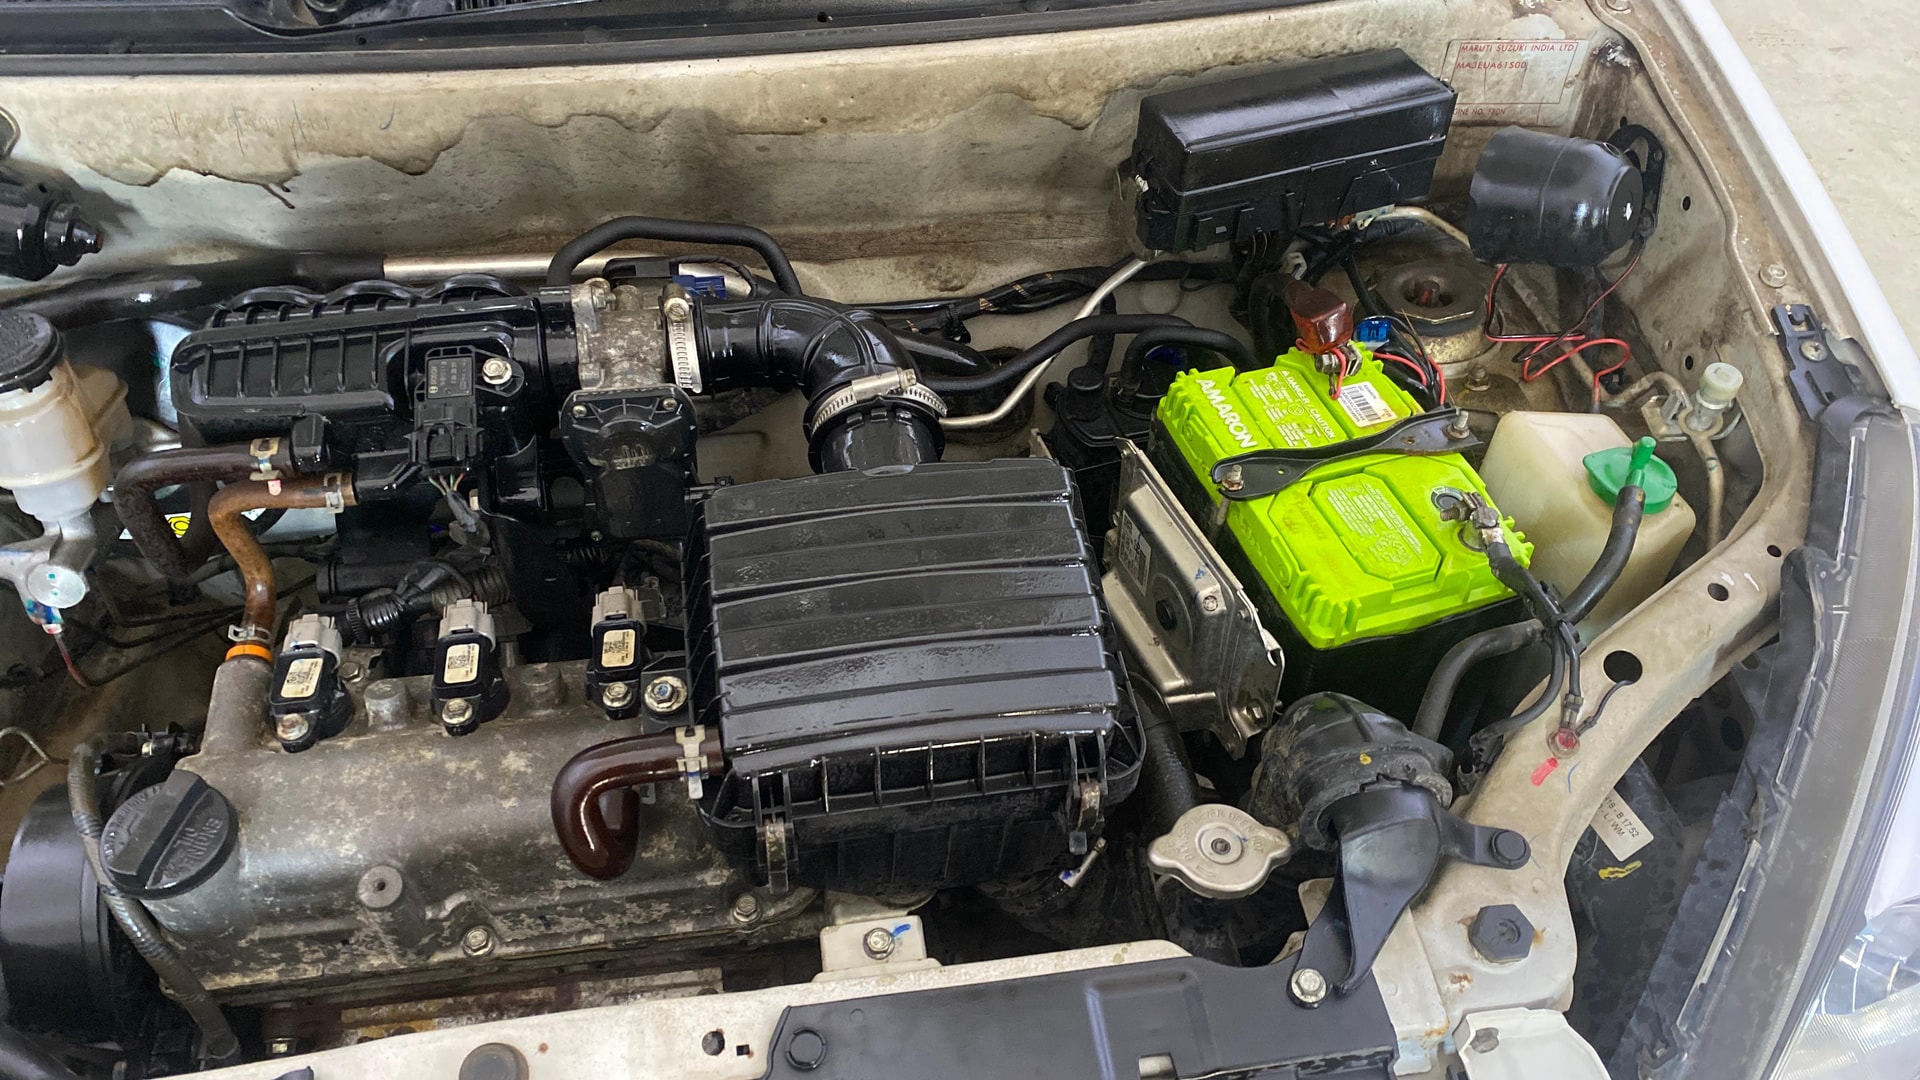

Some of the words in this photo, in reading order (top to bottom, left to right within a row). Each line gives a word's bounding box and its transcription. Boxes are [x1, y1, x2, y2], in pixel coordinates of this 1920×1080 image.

[1461, 44, 1492, 53] MARUTI
[1496, 44, 1527, 52] SUZUKI
[1531, 44, 1555, 52] INDIA
[1195, 379, 1258, 448] AMARON
[1286, 376, 1310, 404] DANGER
[1309, 407, 1336, 438] CAUTION
